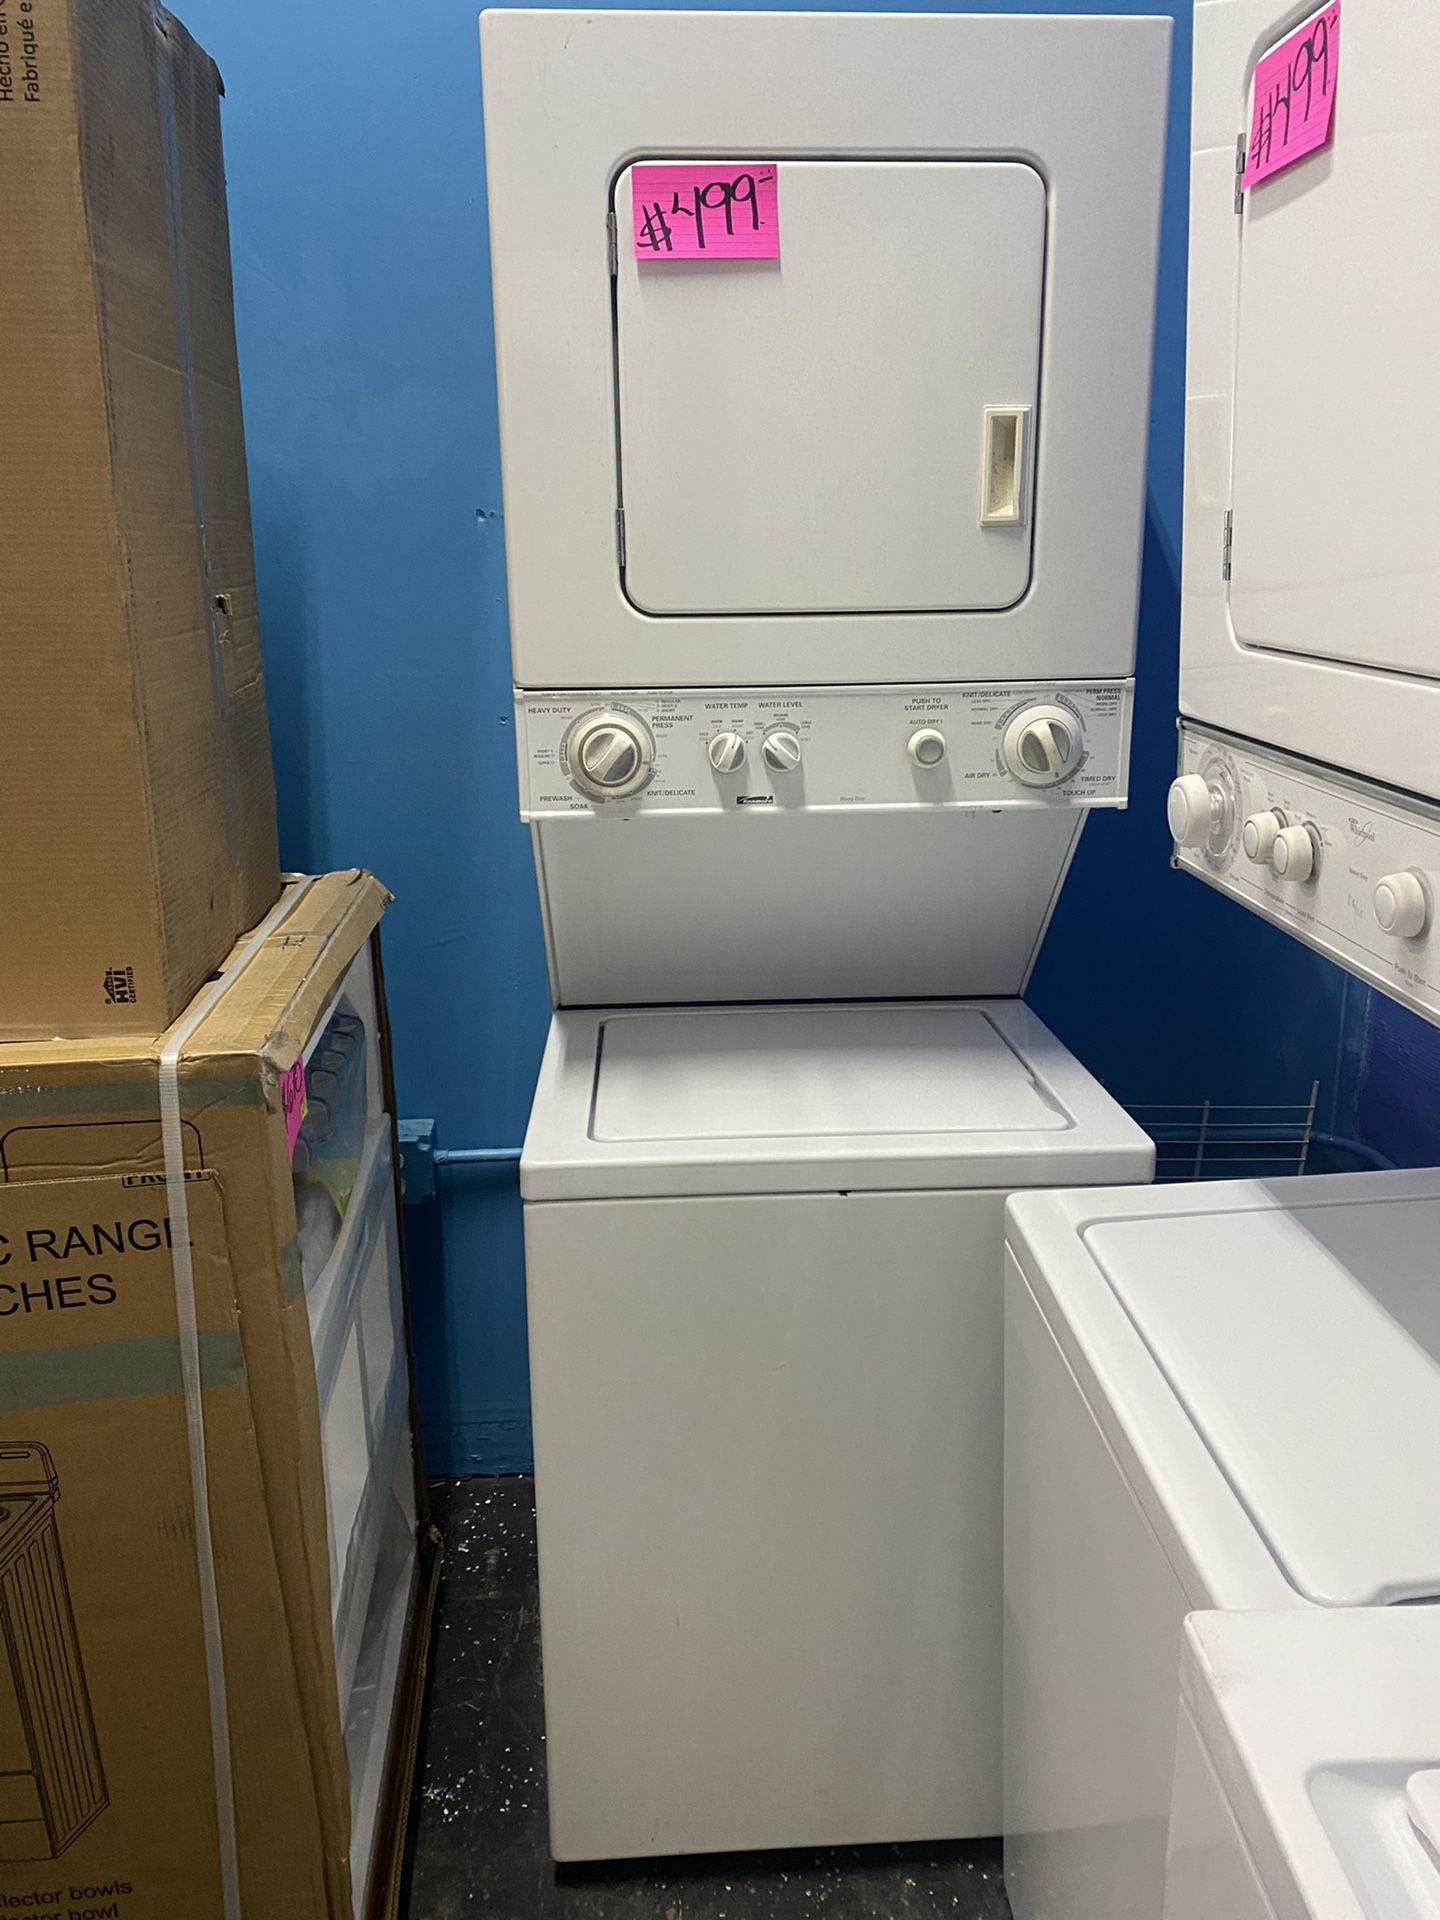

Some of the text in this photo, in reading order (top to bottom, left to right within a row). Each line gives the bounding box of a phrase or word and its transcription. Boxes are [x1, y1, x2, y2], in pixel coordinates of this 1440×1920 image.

[17, 18, 40, 101] Fabriqué
[0, 41, 14, 101] Hecho
[962, 690, 1011, 698] KNIT/DELICATE
[646, 789, 695, 797] KNIT/DELICATE
[0, 1273, 118, 1316] CHES
[69, 1880, 133, 1901] bowls
[68, 1902, 119, 1920] bowl
